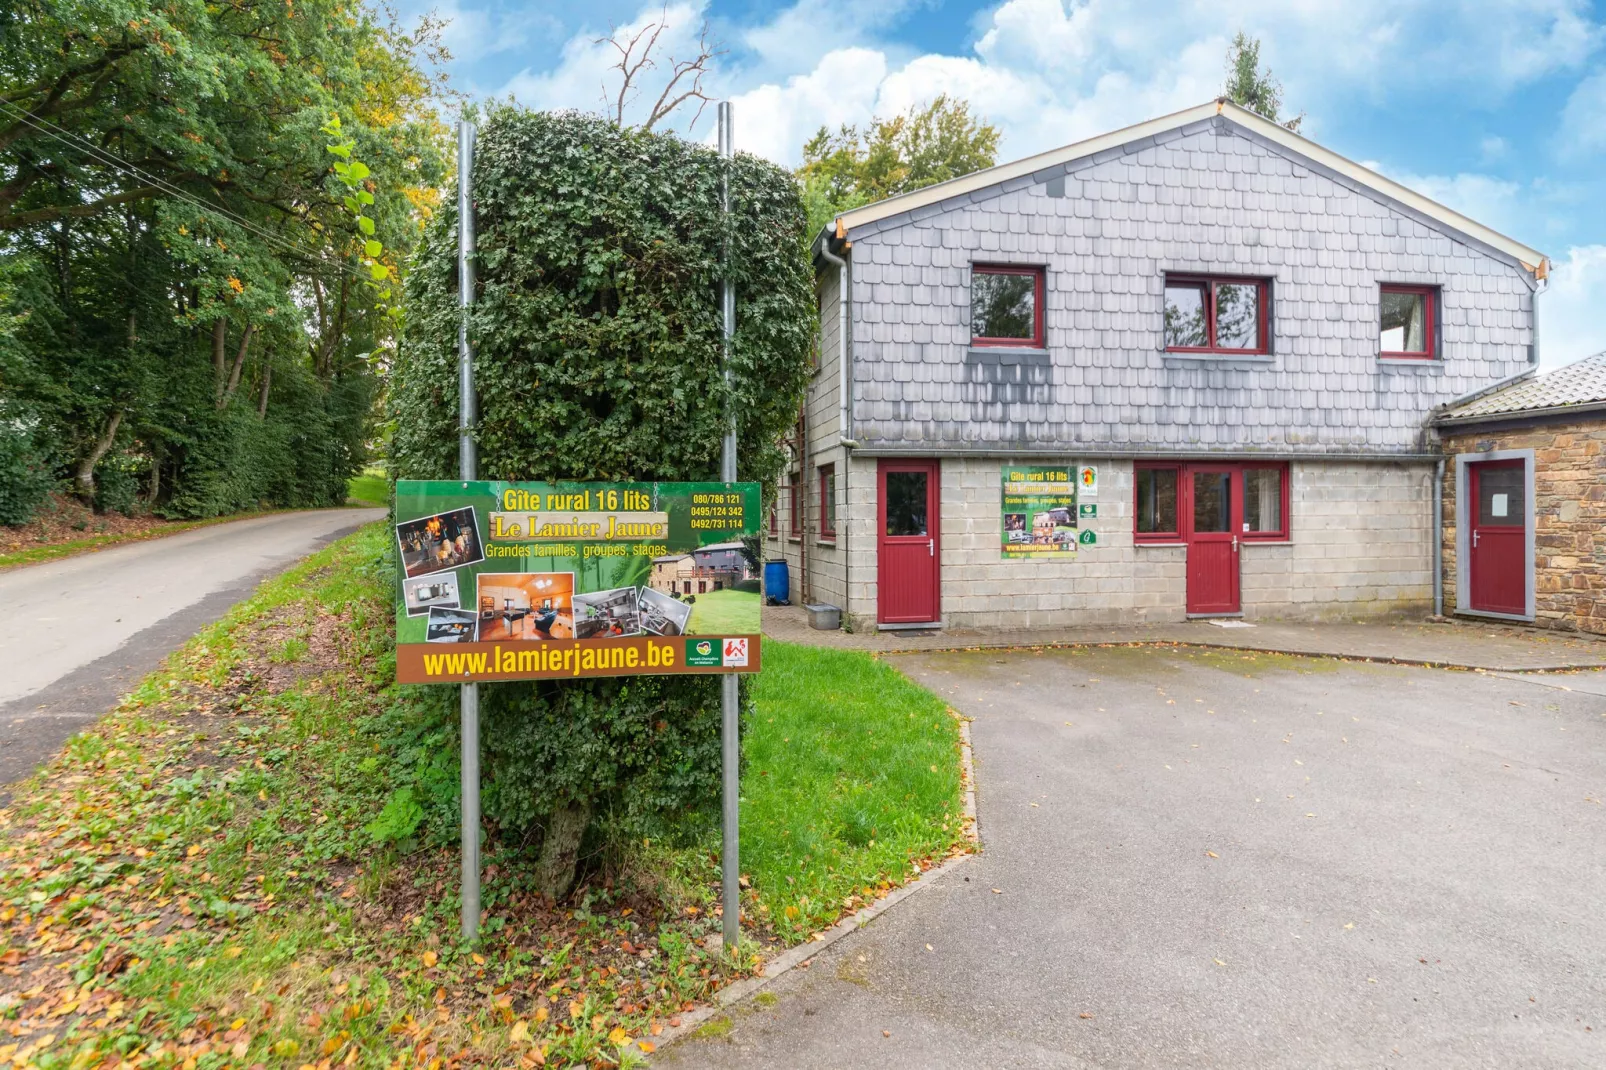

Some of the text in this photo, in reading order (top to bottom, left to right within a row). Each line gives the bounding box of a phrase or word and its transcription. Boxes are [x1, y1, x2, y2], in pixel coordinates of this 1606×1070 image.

[1027, 472, 1044, 481] rural
[1046, 471, 1055, 481] 16
[1056, 471, 1068, 481] lits
[503, 489, 650, 511] Gîte rural 16 lits
[693, 494, 740, 504] 080/786 121
[691, 506, 743, 516] 0495/124 342
[494, 516, 663, 540] Le Lamier Jaune
[691, 519, 743, 529] 0492/731 114
[485, 543, 667, 559] Grandes familles, groupes, stages
[423, 640, 675, 676] www.lamierjaune.be
